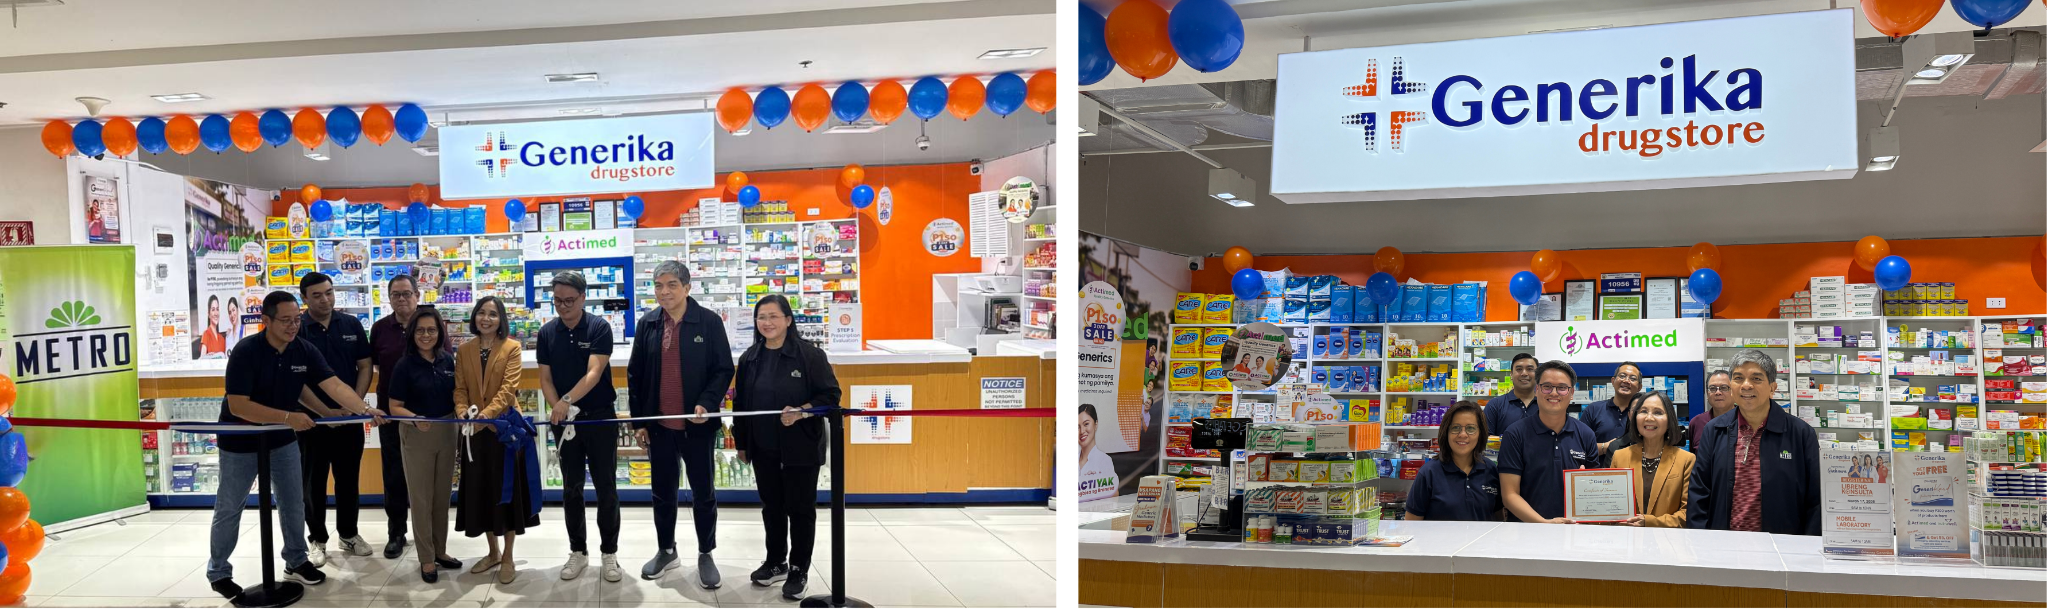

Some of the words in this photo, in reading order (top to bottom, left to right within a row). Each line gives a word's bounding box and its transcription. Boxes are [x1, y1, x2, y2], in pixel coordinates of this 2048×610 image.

[1431, 54, 1763, 127] Generika
[1578, 120, 1765, 157] drugstore
[520, 134, 674, 167] Generika
[590, 164, 675, 182] drugstore
[557, 236, 617, 251] Actimed
[207, 262, 223, 271] Quality
[1086, 307, 1117, 325] P1so
[1085, 328, 1114, 340] SALE
[1585, 329, 1677, 350] Actimed
[15, 332, 131, 377] METRO
[1174, 367, 1198, 375] CARE
[983, 380, 1023, 388] NOTICE
[1307, 411, 1334, 421] P1so
[1926, 465, 1948, 475] FREE
